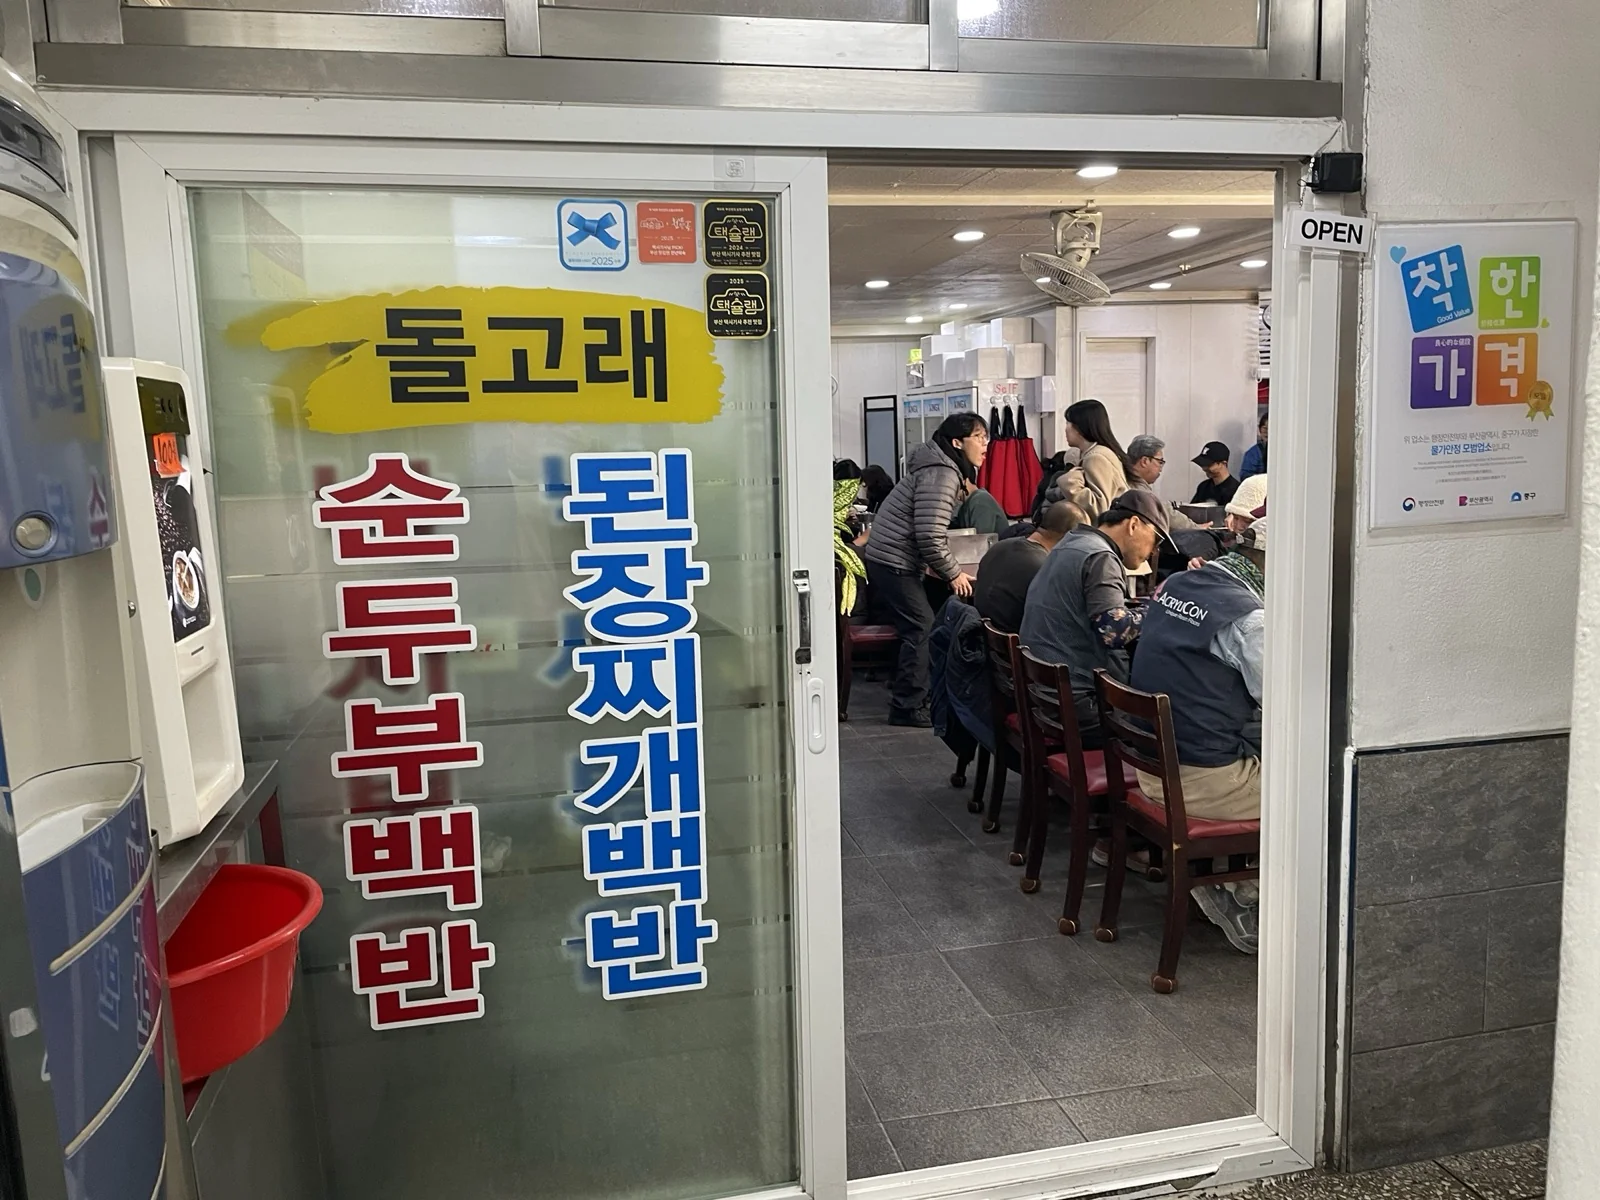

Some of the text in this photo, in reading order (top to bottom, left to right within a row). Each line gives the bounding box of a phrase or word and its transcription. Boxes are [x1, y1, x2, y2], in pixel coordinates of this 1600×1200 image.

[1301, 218, 1363, 244] OPEN
[591, 257, 614, 266] 2025
[1436, 308, 1471, 324] Good Value
[376, 307, 668, 403] 돌고래
[1404, 436, 1410, 444] 위
[1411, 435, 1430, 444] 업소는
[1501, 430, 1520, 438] 중구가
[1431, 442, 1510, 456] 물가안정 모범업소입니다
[1469, 496, 1494, 504] 부산광역시
[1524, 492, 1536, 500] 중구
